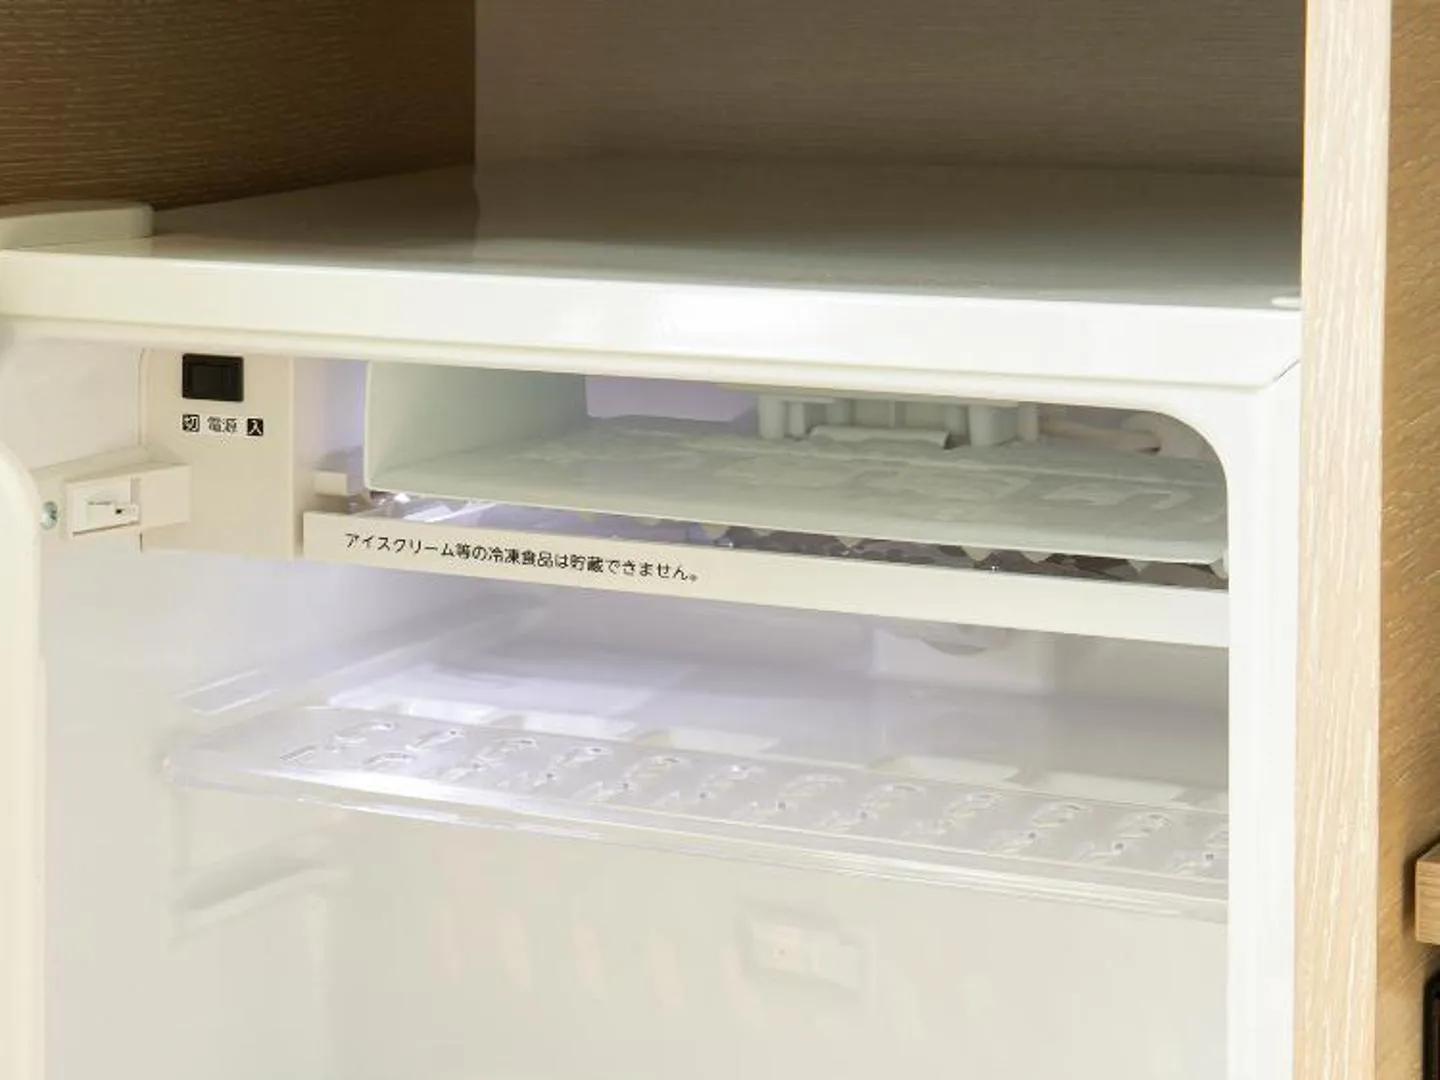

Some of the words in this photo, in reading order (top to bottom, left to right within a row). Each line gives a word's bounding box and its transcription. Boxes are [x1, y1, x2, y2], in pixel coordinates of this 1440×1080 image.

[207, 416, 237, 433] 電源
[247, 418, 263, 436] 入
[344, 532, 698, 582] アイスクリーム等の冷凍食品は貯蔵できません。
